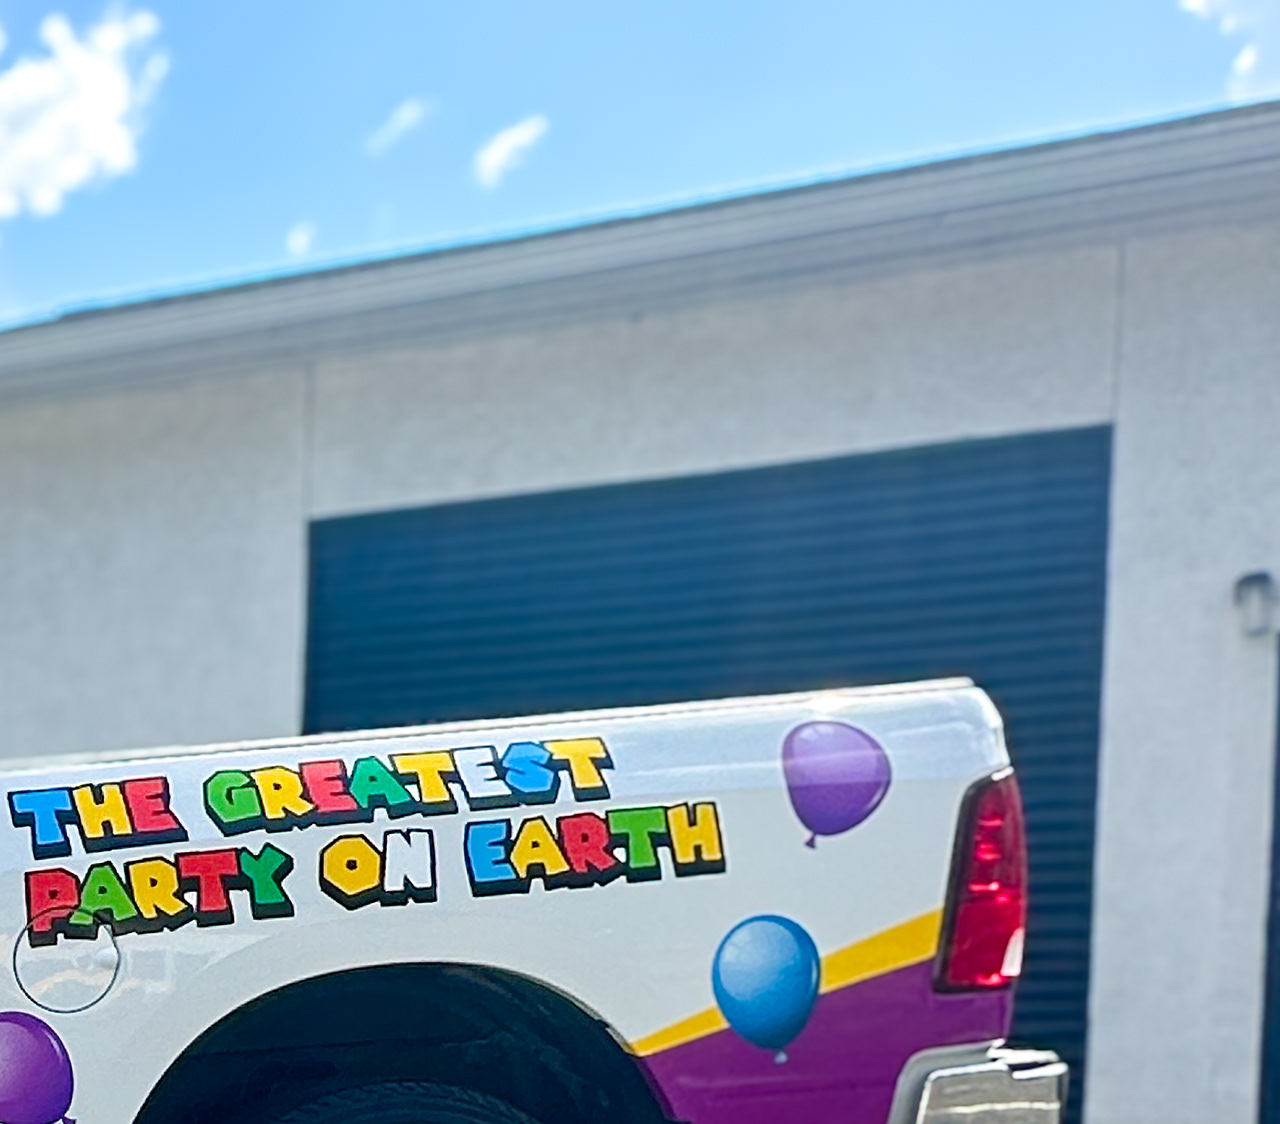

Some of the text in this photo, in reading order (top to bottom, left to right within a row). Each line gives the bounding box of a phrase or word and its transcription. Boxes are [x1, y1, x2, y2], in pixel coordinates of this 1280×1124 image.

[8, 736, 616, 860] THE GREATEST
[25, 801, 727, 948] PARTY ON EARTH
